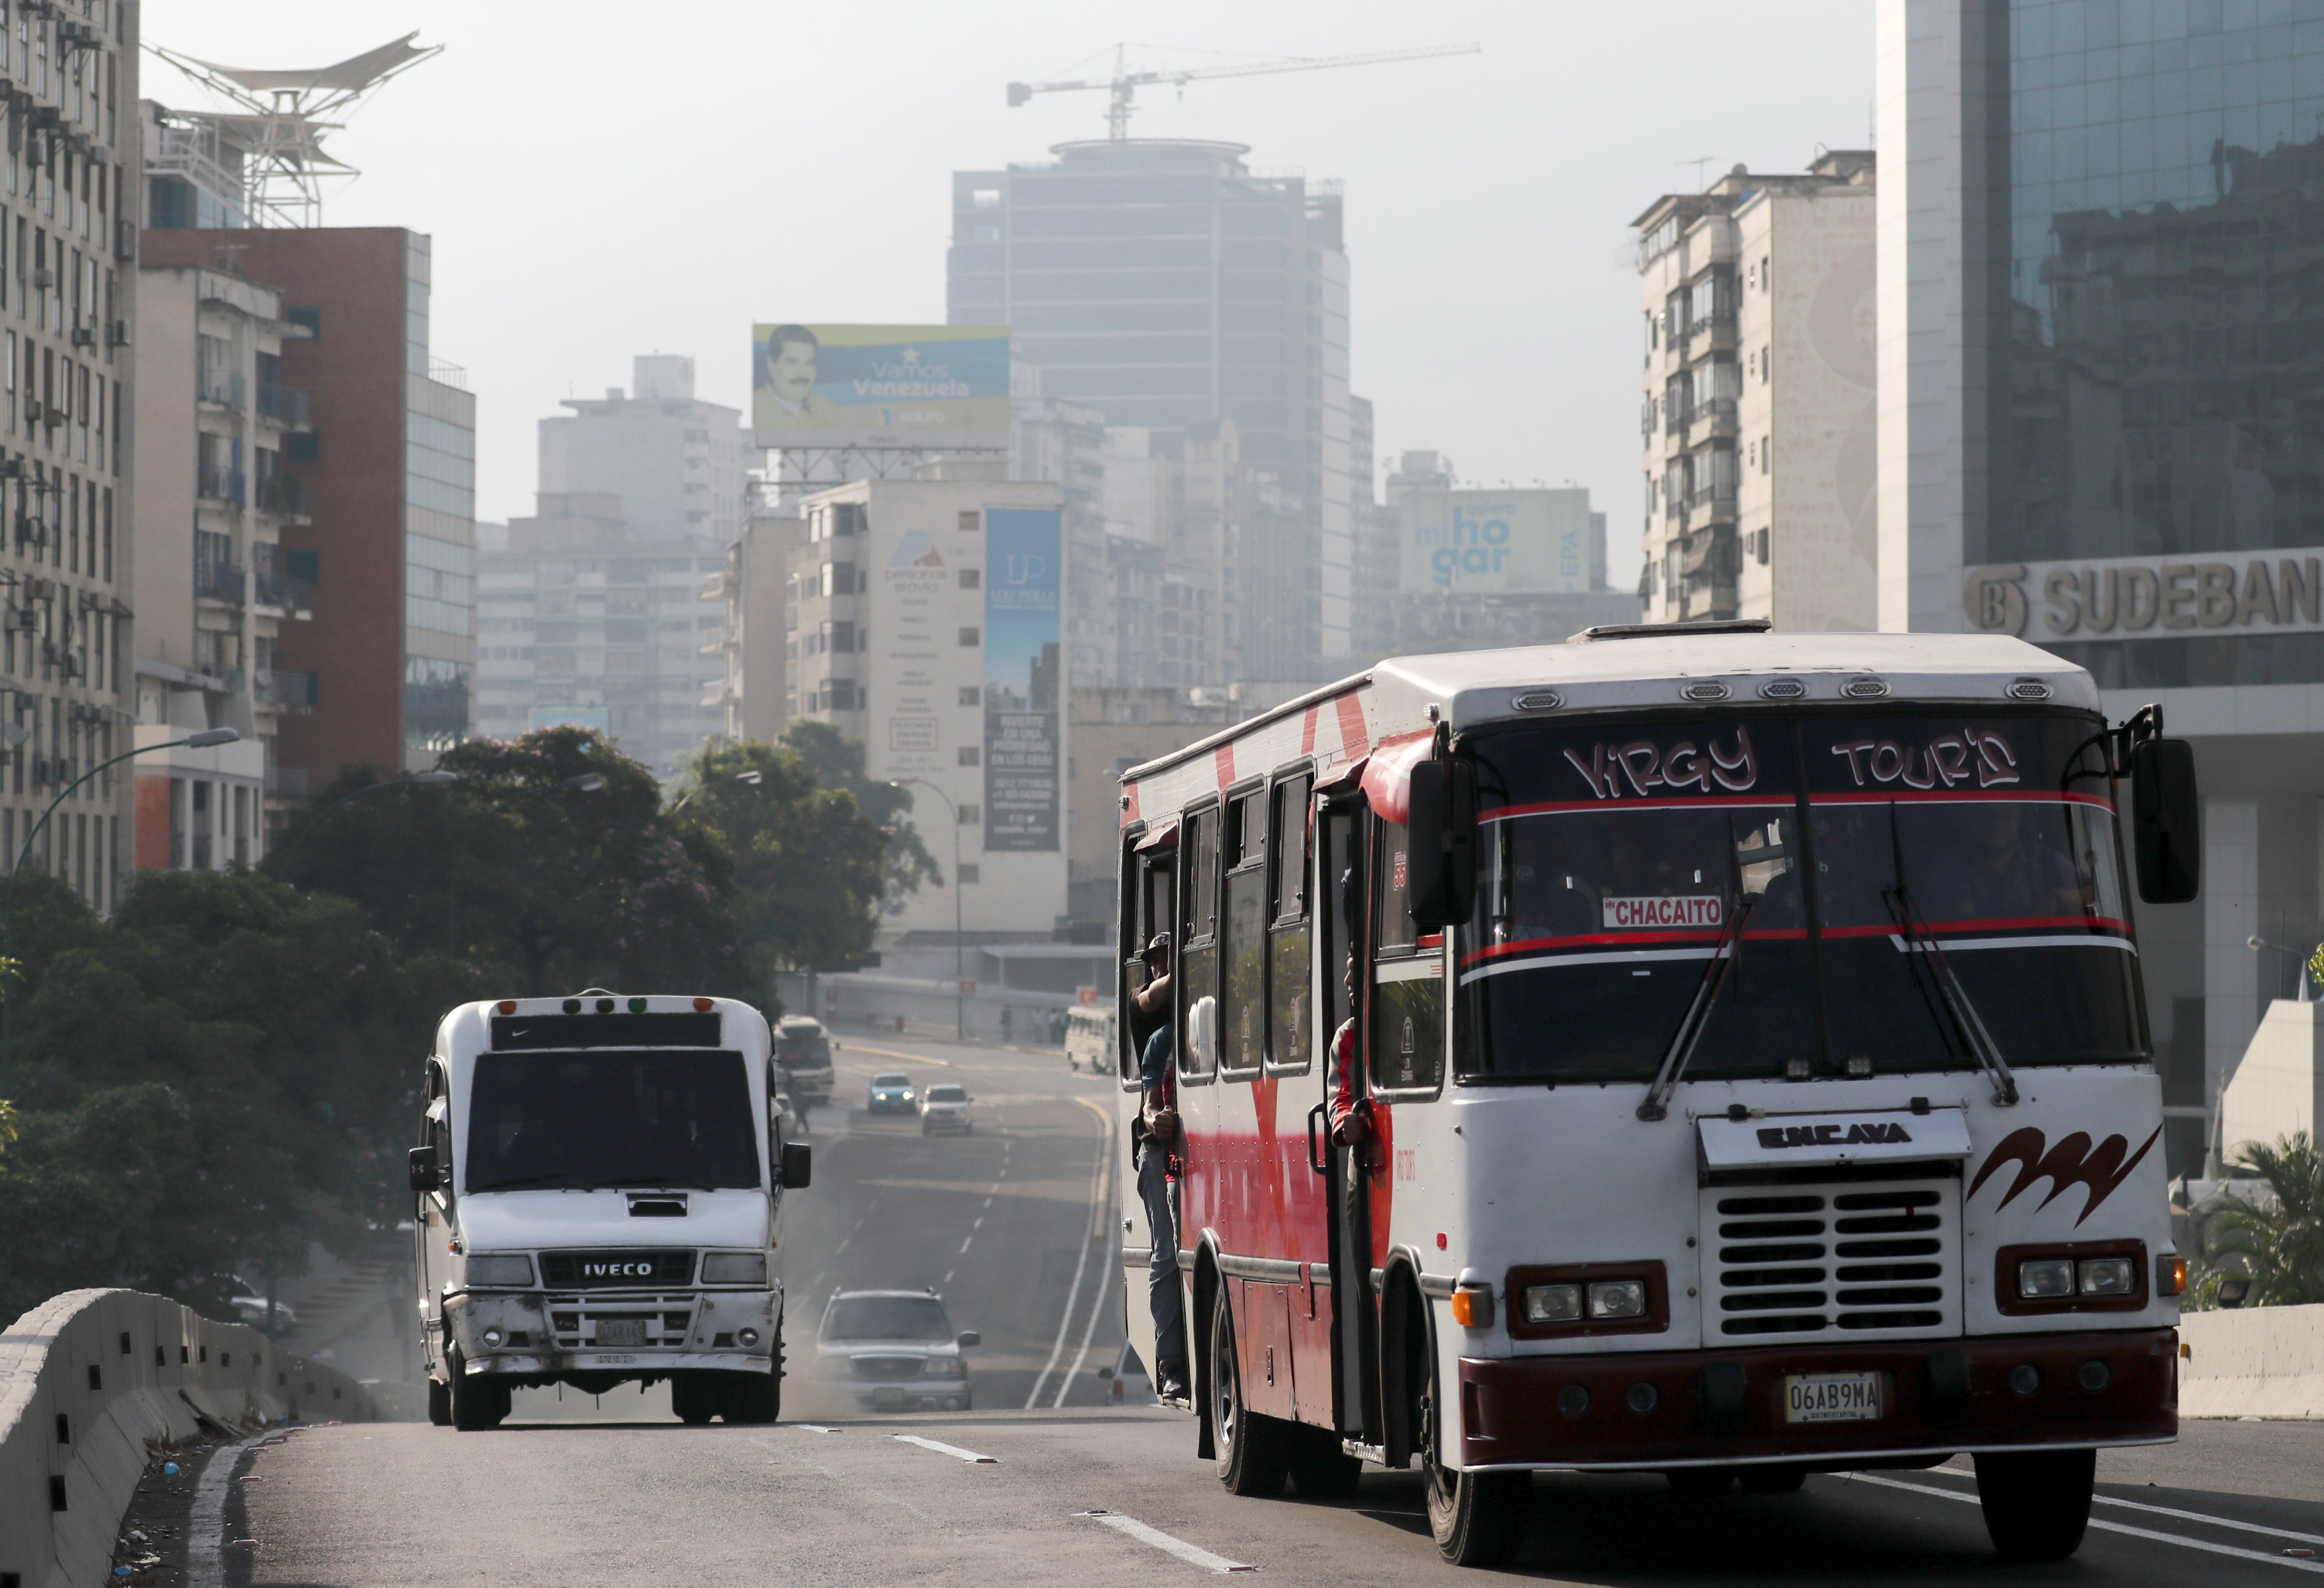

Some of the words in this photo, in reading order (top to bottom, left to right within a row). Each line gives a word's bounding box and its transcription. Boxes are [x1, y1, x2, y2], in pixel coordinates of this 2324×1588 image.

[872, 361, 949, 379] Vamos
[853, 378, 970, 397] Venezuela
[1416, 521, 1449, 545] mi
[1560, 529, 1578, 577] EPA
[884, 571, 946, 581] persianas
[2044, 557, 2319, 636] SUDEBAN
[1394, 862, 1406, 888] 55
[1616, 899, 1721, 925] CHACAITO
[1756, 1122, 1912, 1149] ENCAVA
[584, 1263, 652, 1276] IVECO
[1791, 1381, 1876, 1410] 06AB9MA
